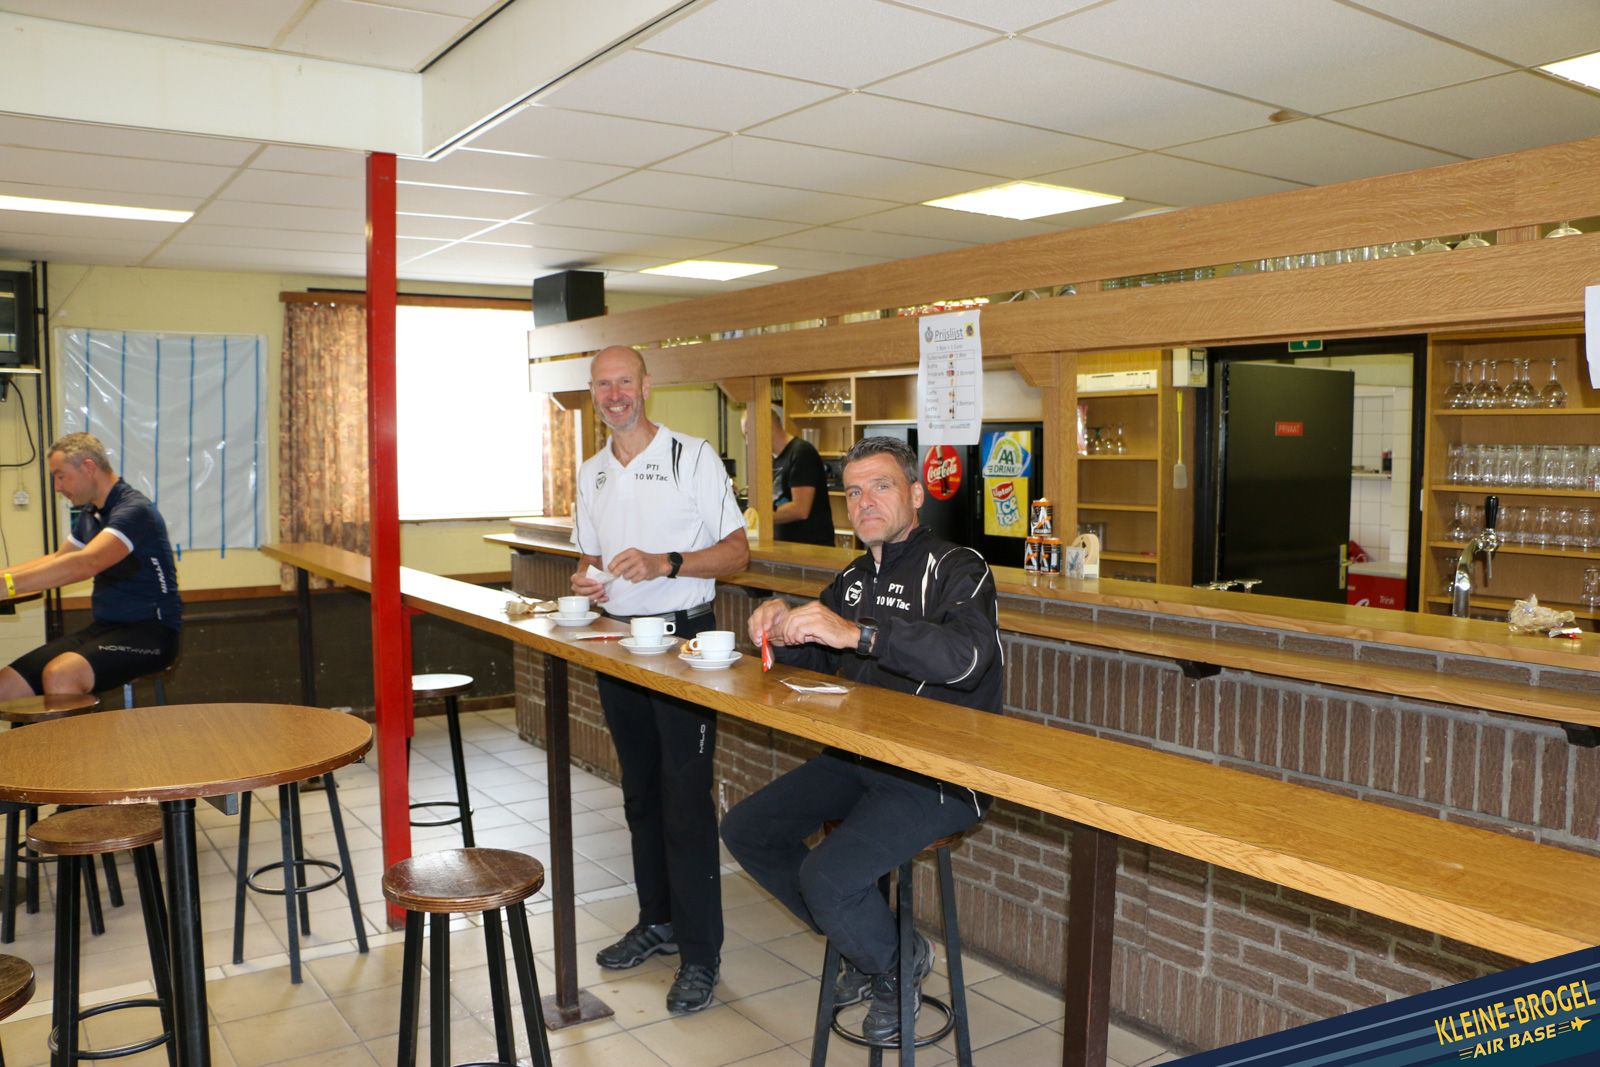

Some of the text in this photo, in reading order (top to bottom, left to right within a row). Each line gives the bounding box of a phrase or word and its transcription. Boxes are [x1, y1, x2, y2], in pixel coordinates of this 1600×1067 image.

[934, 328, 964, 342] Prijslijst
[998, 448, 1014, 465] AA
[646, 463, 659, 471] PTI
[655, 473, 669, 482] Tac
[888, 582, 905, 595] PTI
[876, 595, 911, 611] 10 W Tac
